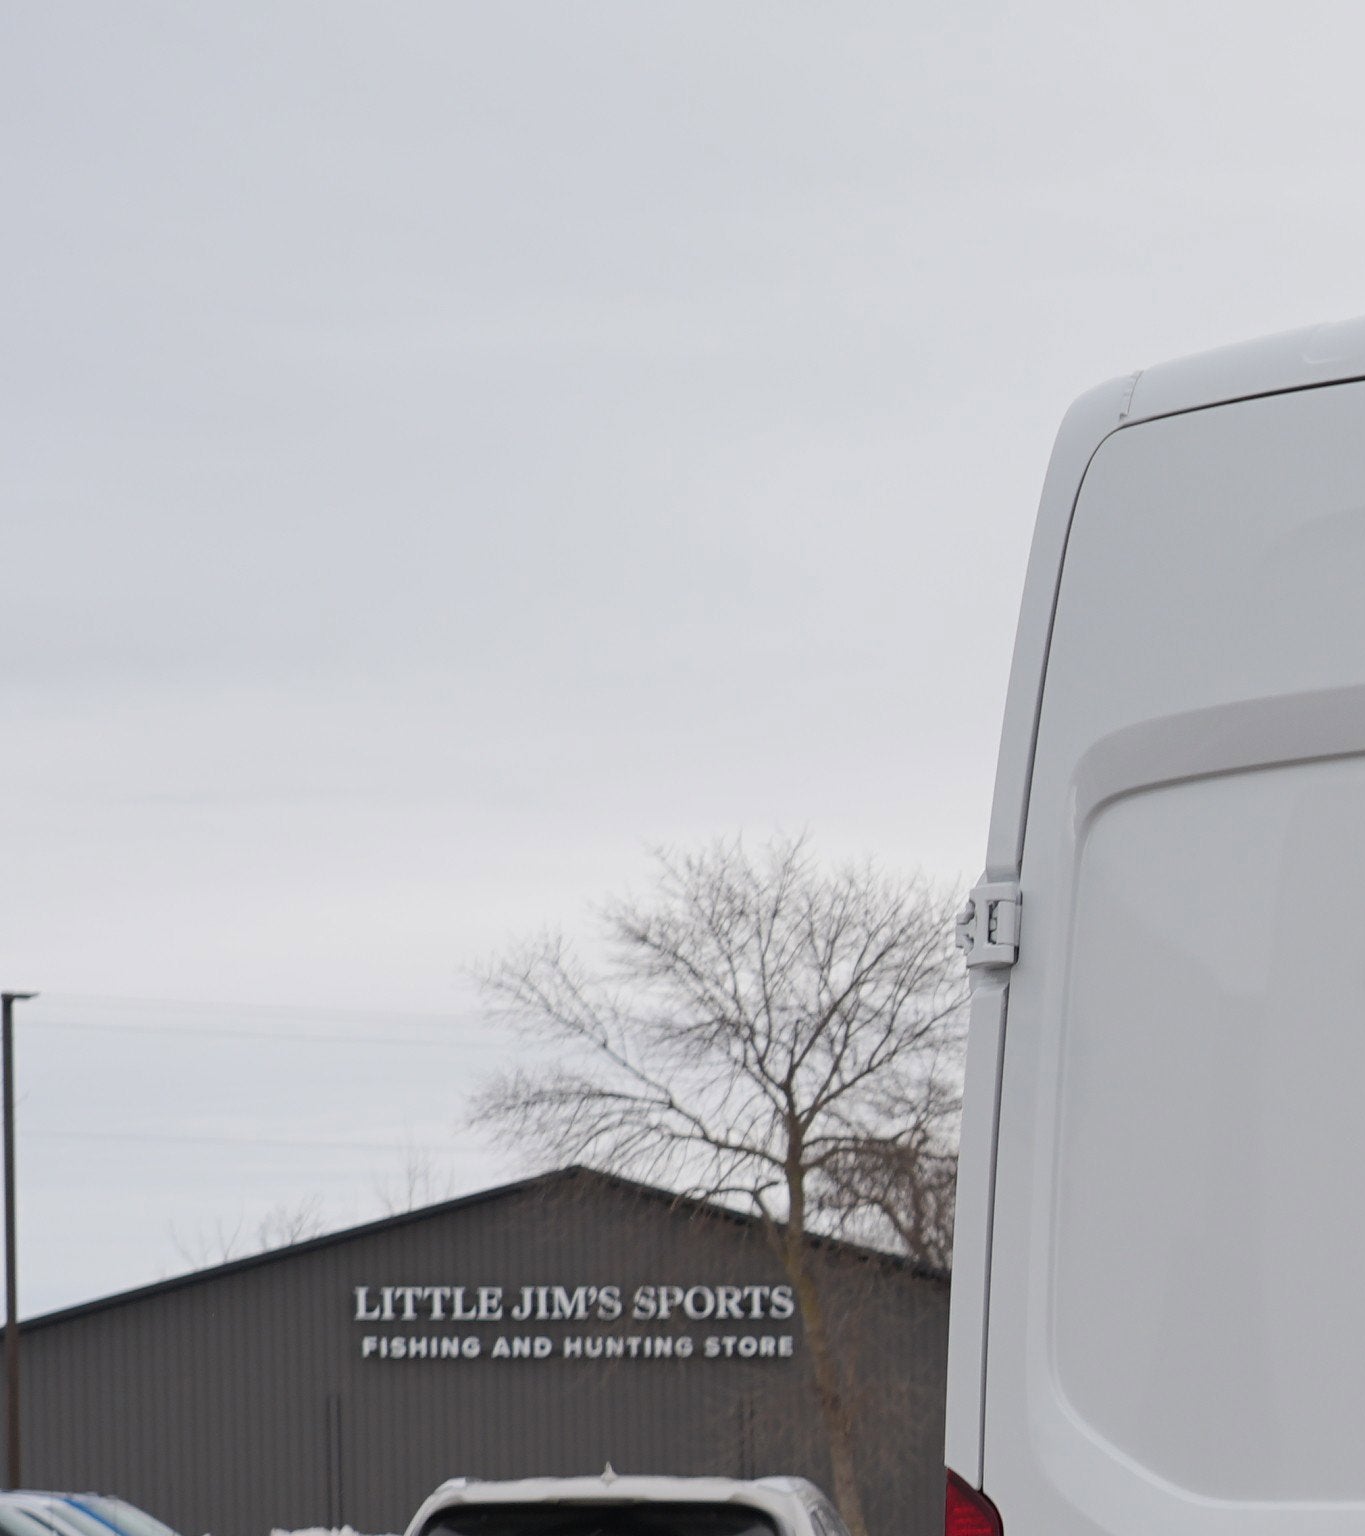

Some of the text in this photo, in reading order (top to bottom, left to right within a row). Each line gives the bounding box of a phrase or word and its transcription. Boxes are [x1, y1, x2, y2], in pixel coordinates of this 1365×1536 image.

[354, 1286, 795, 1321] LITTLE JIM'S SPORTS
[362, 1335, 794, 1359] FISHING AND HUNTING STORE
